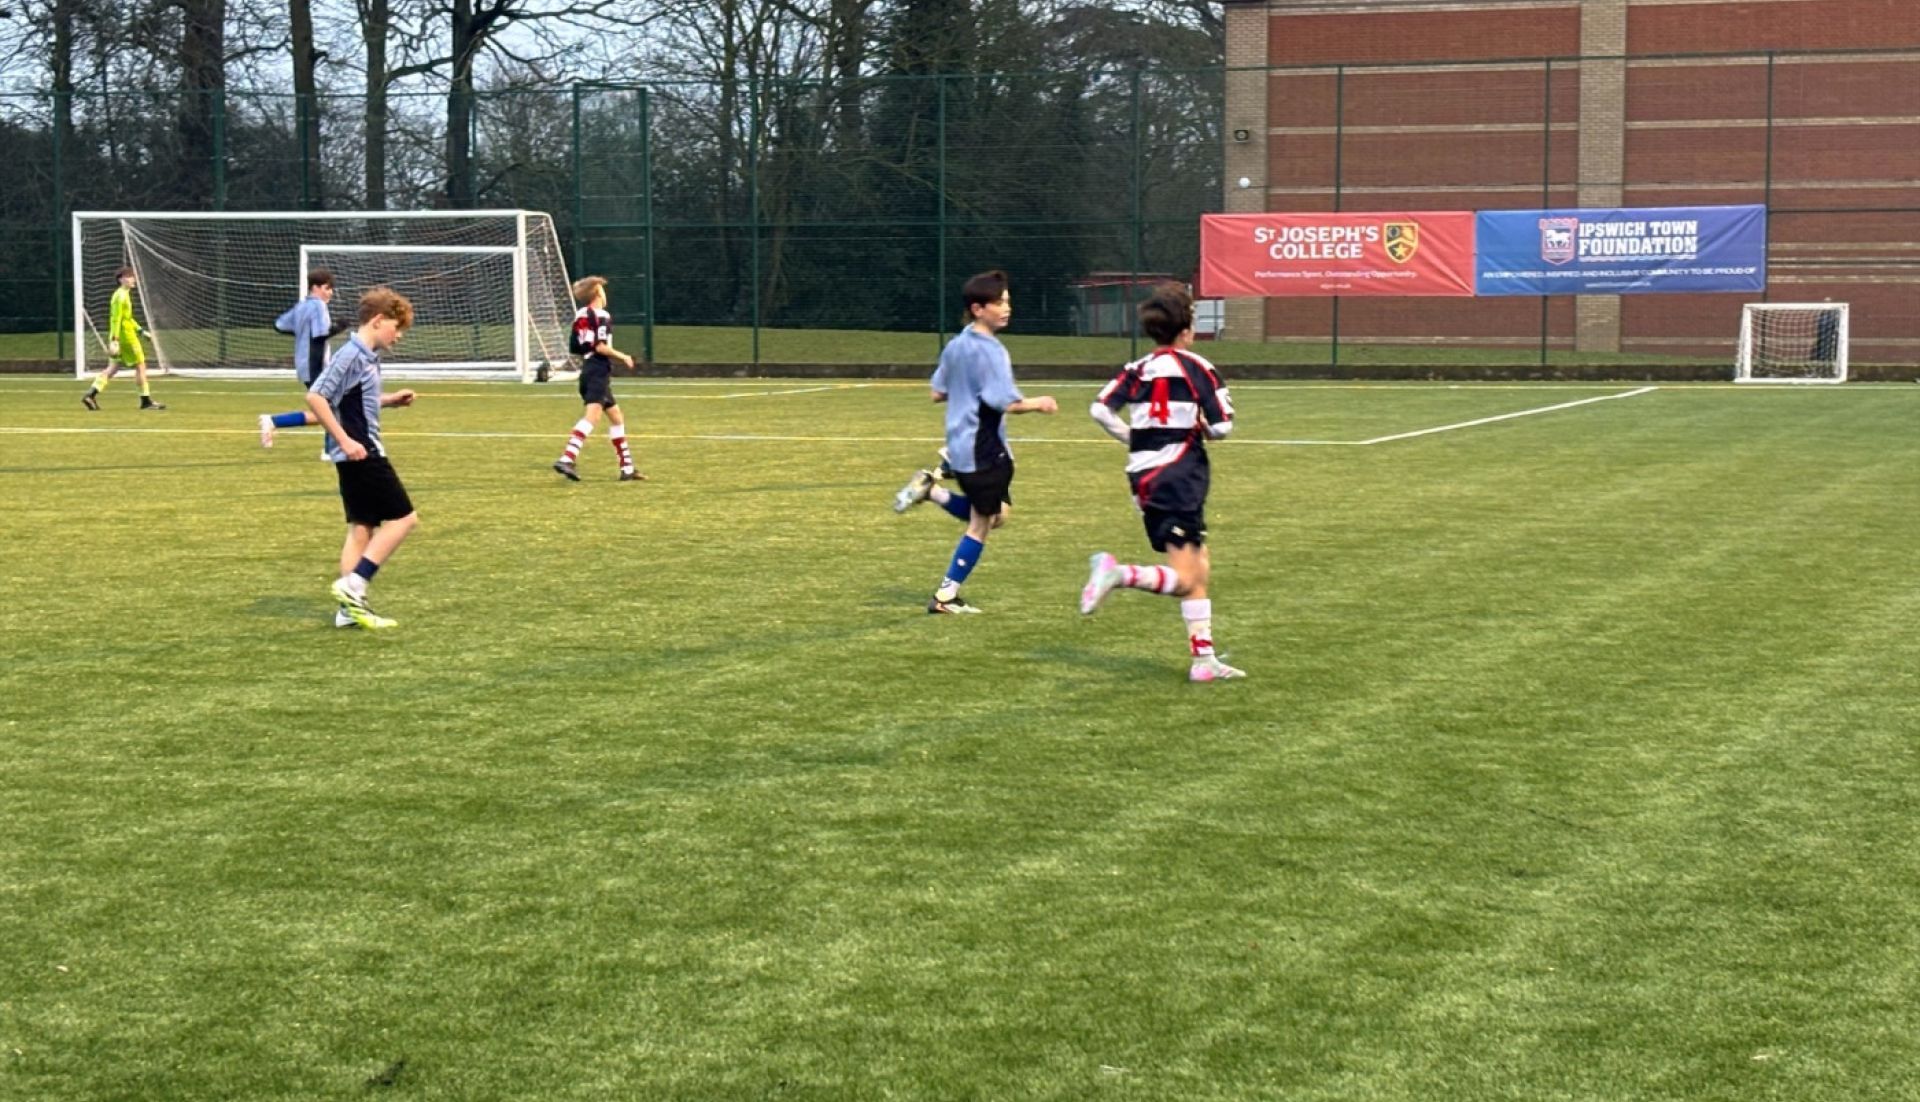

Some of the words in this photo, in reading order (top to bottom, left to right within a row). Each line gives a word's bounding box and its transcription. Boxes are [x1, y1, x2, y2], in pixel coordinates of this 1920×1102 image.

[1278, 226, 1379, 243] JOSEPH'S
[1578, 221, 1646, 238] IPSWICH
[1650, 220, 1698, 236] TOWN
[1270, 243, 1364, 260] COLLEGE
[1578, 236, 1698, 256] FOUNDATION
[1149, 377, 1170, 425] 4
